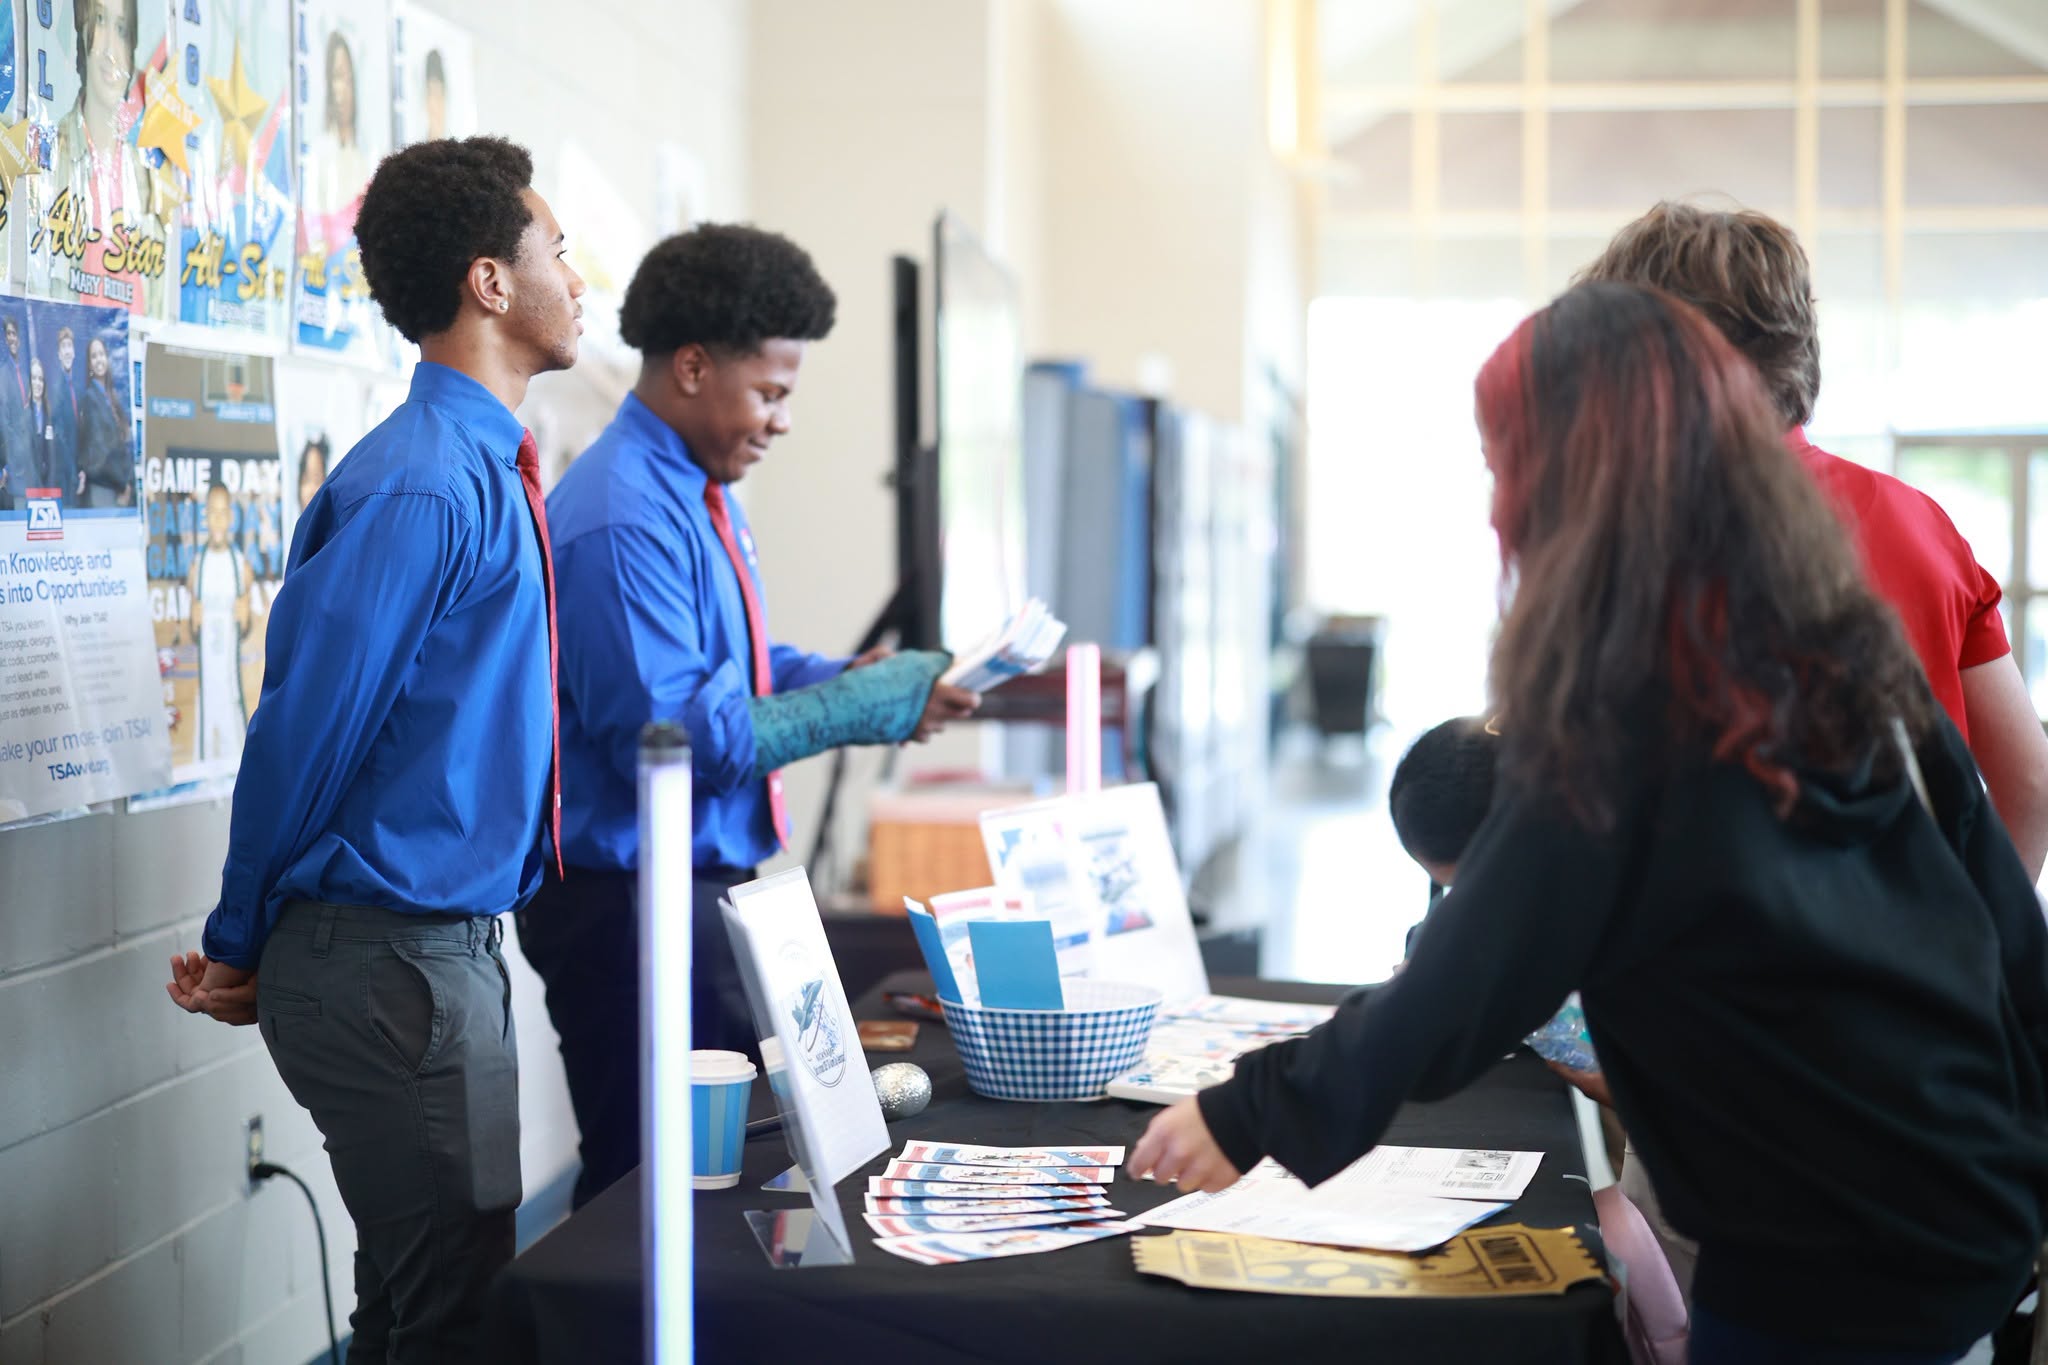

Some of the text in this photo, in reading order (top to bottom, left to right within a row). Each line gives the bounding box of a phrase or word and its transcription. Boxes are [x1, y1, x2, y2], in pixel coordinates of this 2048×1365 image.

[146, 456, 284, 495] GAME DAY
[27, 500, 63, 529] TSA
[9, 552, 85, 576] Knowledge
[87, 548, 113, 570] and
[8, 582, 34, 604] into
[36, 577, 128, 605] Opportunities
[25, 735, 59, 763] your
